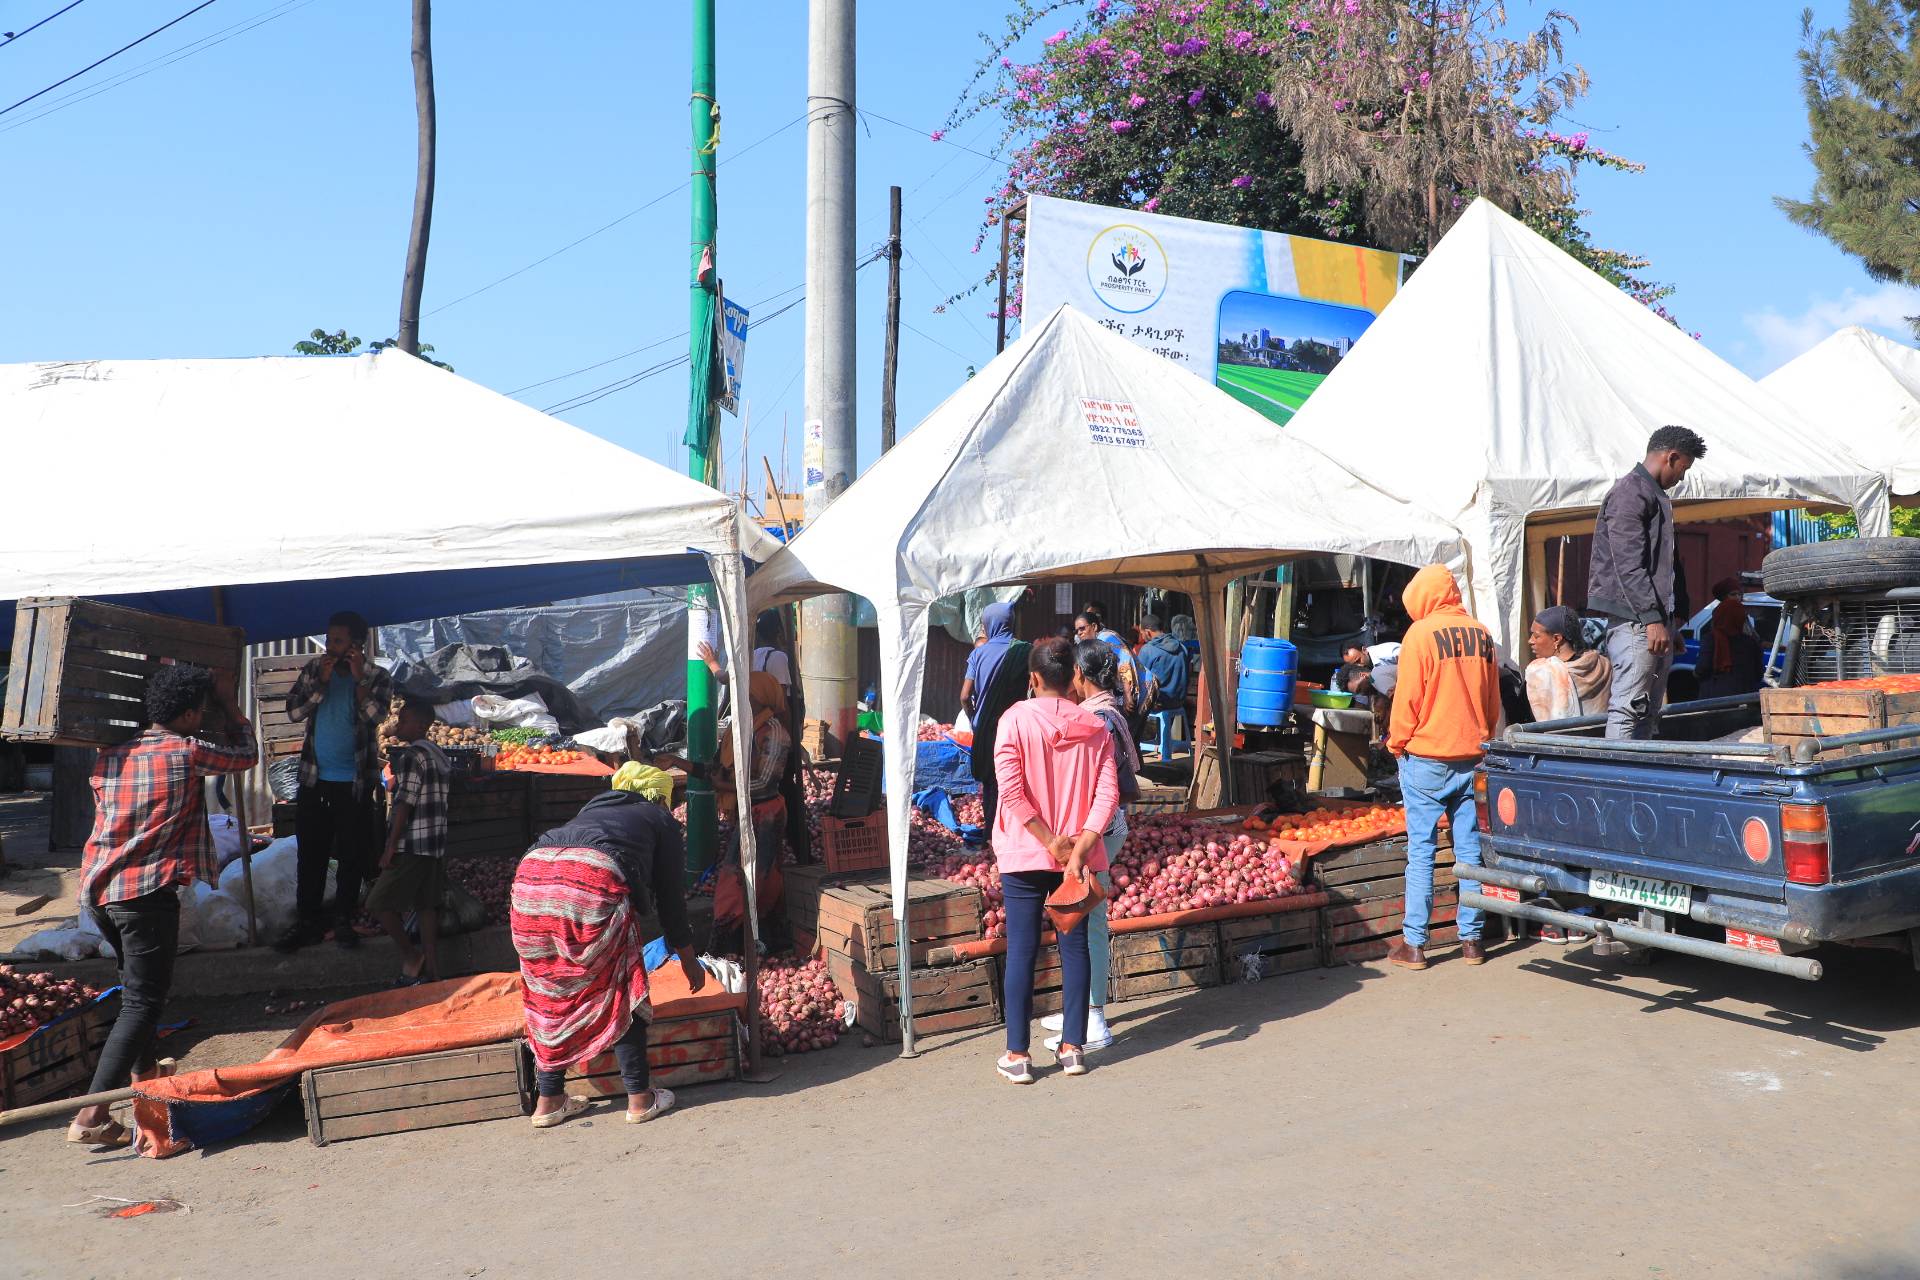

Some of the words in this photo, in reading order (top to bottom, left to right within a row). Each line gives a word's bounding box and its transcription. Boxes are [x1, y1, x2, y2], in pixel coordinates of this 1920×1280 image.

[1100, 281, 1133, 292] PROSPERITY
[1134, 286, 1152, 295] PARTY
[1089, 424, 1111, 434] 0922
[1092, 434, 1114, 444] 0913
[1516, 788, 1743, 856] TOYOTA
